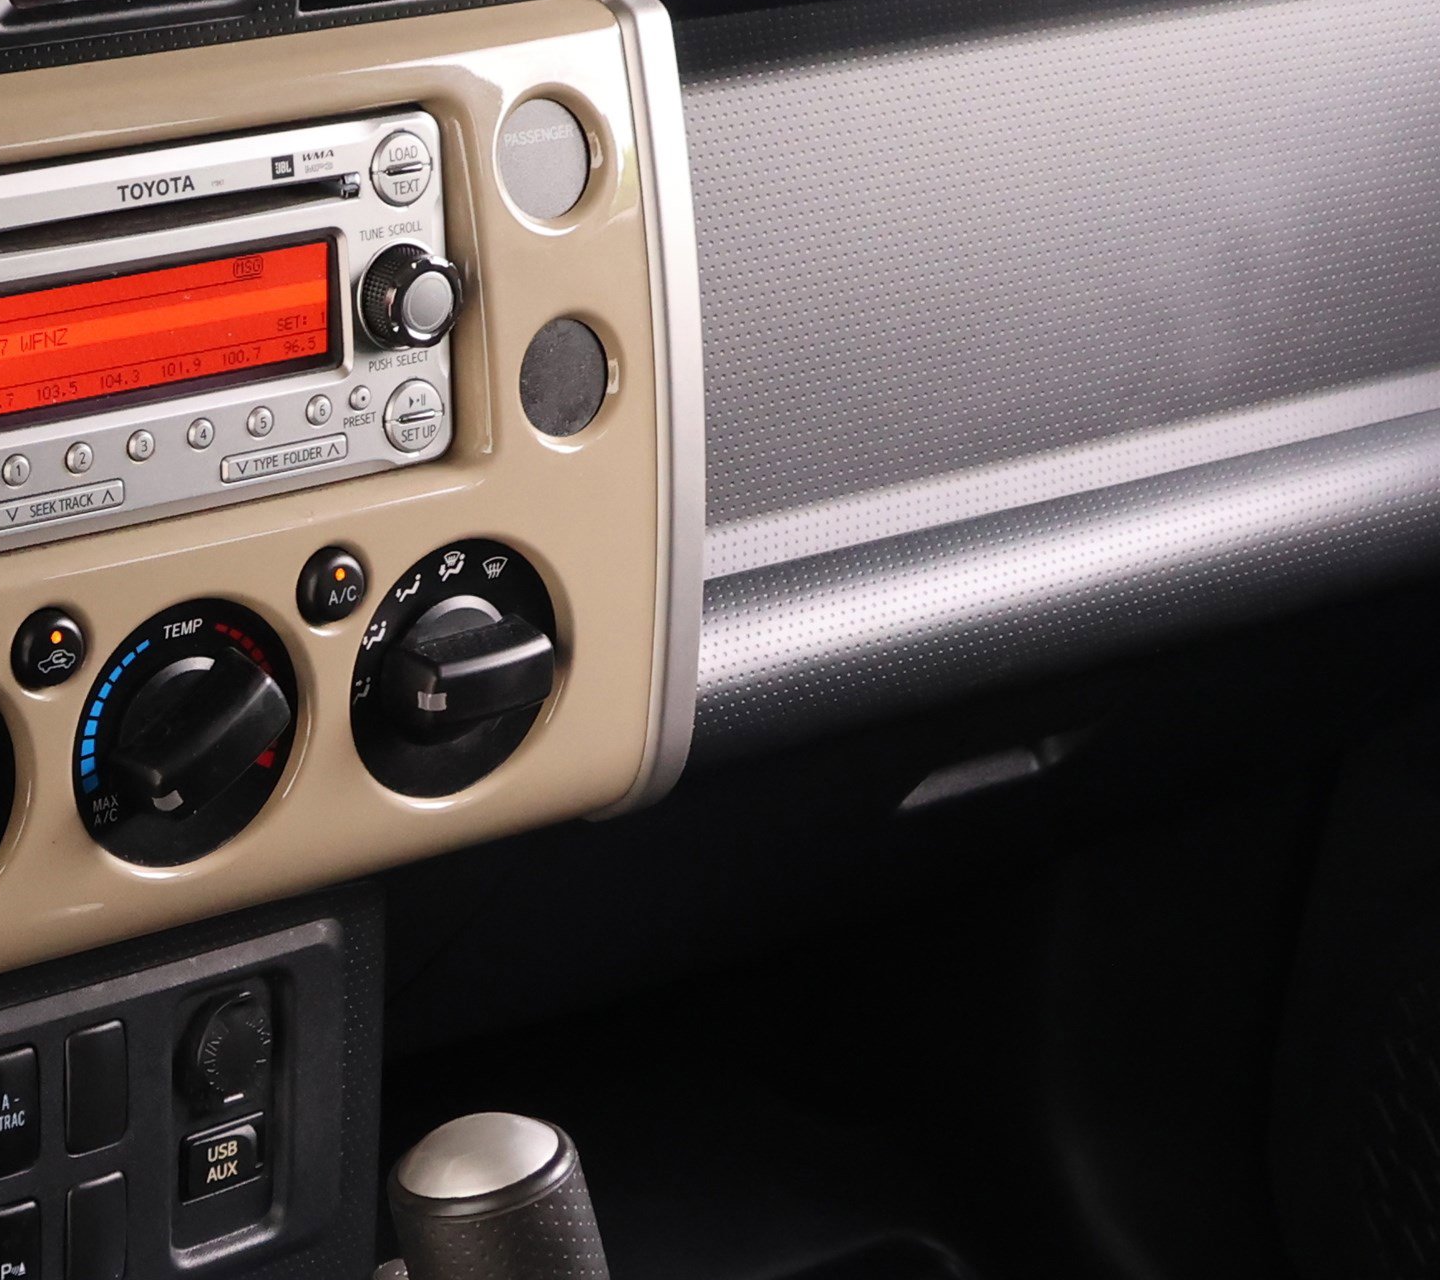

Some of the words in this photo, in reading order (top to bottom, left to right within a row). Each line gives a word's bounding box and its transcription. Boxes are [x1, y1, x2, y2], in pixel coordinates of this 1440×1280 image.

[503, 124, 574, 148] PASSENGER
[302, 149, 335, 162] WMA
[389, 145, 419, 162] LOAD
[274, 160, 292, 175] JBL
[117, 175, 195, 202] TOYOTA
[392, 178, 420, 196] TEXT
[360, 228, 384, 242] TUNE
[388, 221, 423, 238] SCROLL
[20, 328, 68, 353] WFNZ
[36, 381, 78, 401] 103.5
[99, 369, 141, 388] 104.3
[161, 358, 201, 378] 101.9
[222, 347, 261, 367] 100.7
[283, 336, 316, 355] 96.5
[368, 359, 393, 373] PUSH
[396, 349, 429, 367] SELECT
[319, 404, 327, 417] 6
[259, 417, 267, 429] 5
[343, 412, 375, 429] PRESET
[200, 428, 207, 441] 4
[401, 427, 419, 443] SET
[422, 424, 437, 438] UP
[140, 439, 148, 453] 3
[78, 451, 87, 466] 2
[253, 457, 279, 472] TYPE
[283, 447, 323, 466] FOLDER
[29, 501, 55, 518] SEEK
[58, 494, 93, 513] TRACK
[328, 585, 357, 606] A/C
[163, 618, 203, 640] TEMP
[93, 793, 119, 812] MAX
[94, 807, 118, 826] A/C
[207, 1140, 238, 1163] USB
[206, 1160, 239, 1184] AUX
